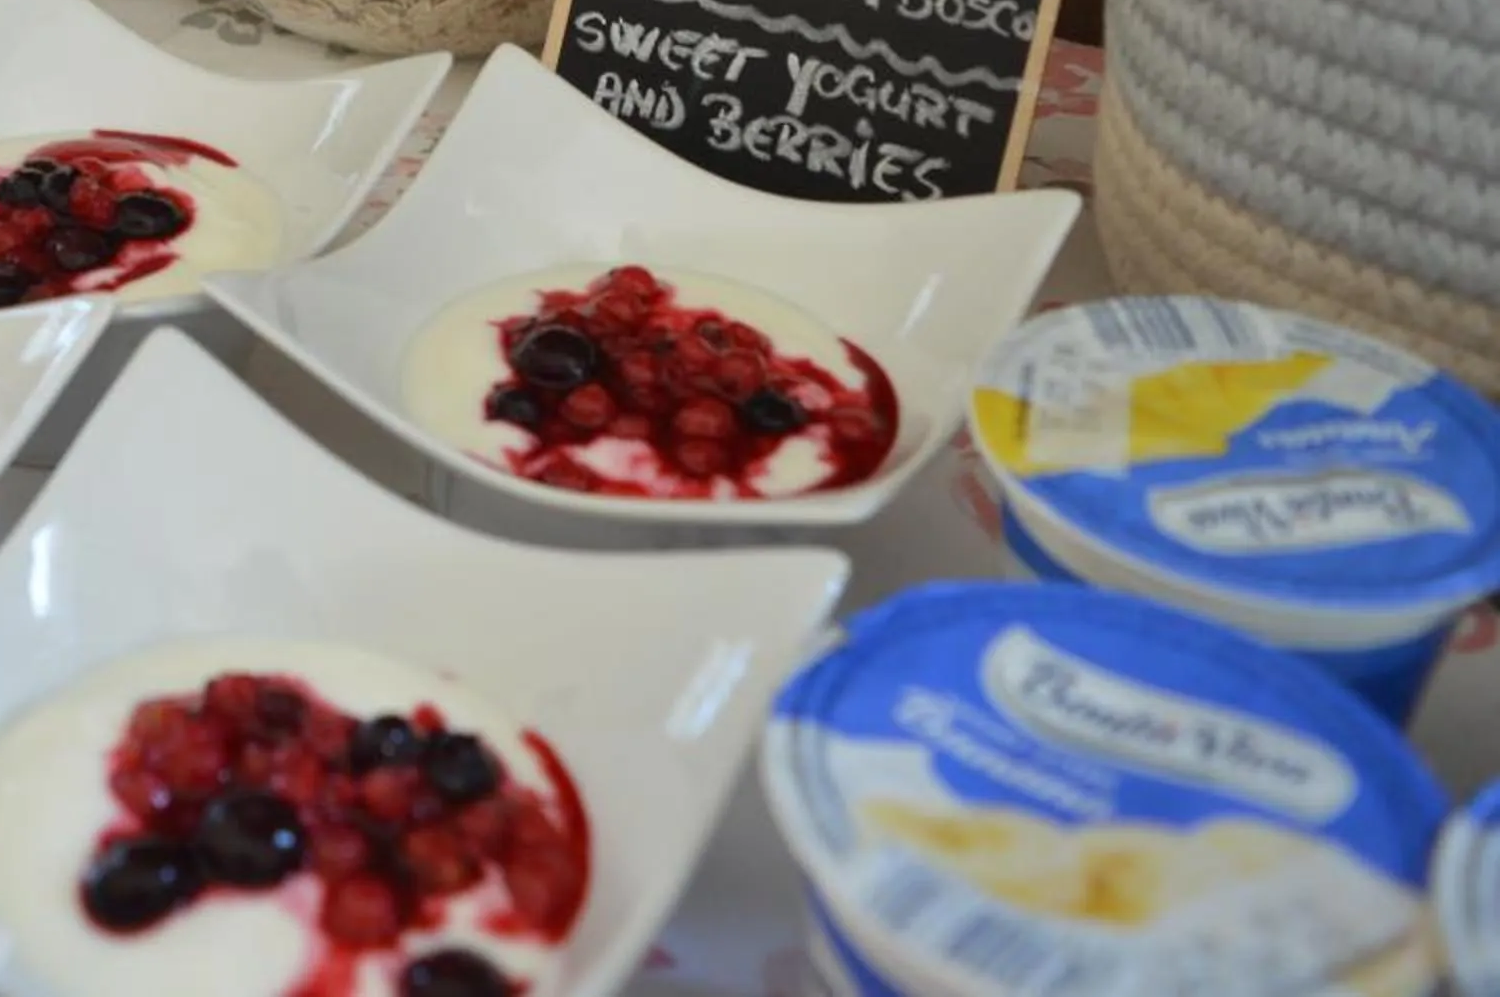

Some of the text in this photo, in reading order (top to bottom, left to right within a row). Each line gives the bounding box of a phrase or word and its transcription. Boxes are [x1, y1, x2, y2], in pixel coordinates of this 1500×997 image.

[575, 12, 995, 138] SWEET YOGURT
[593, 71, 686, 130] AND
